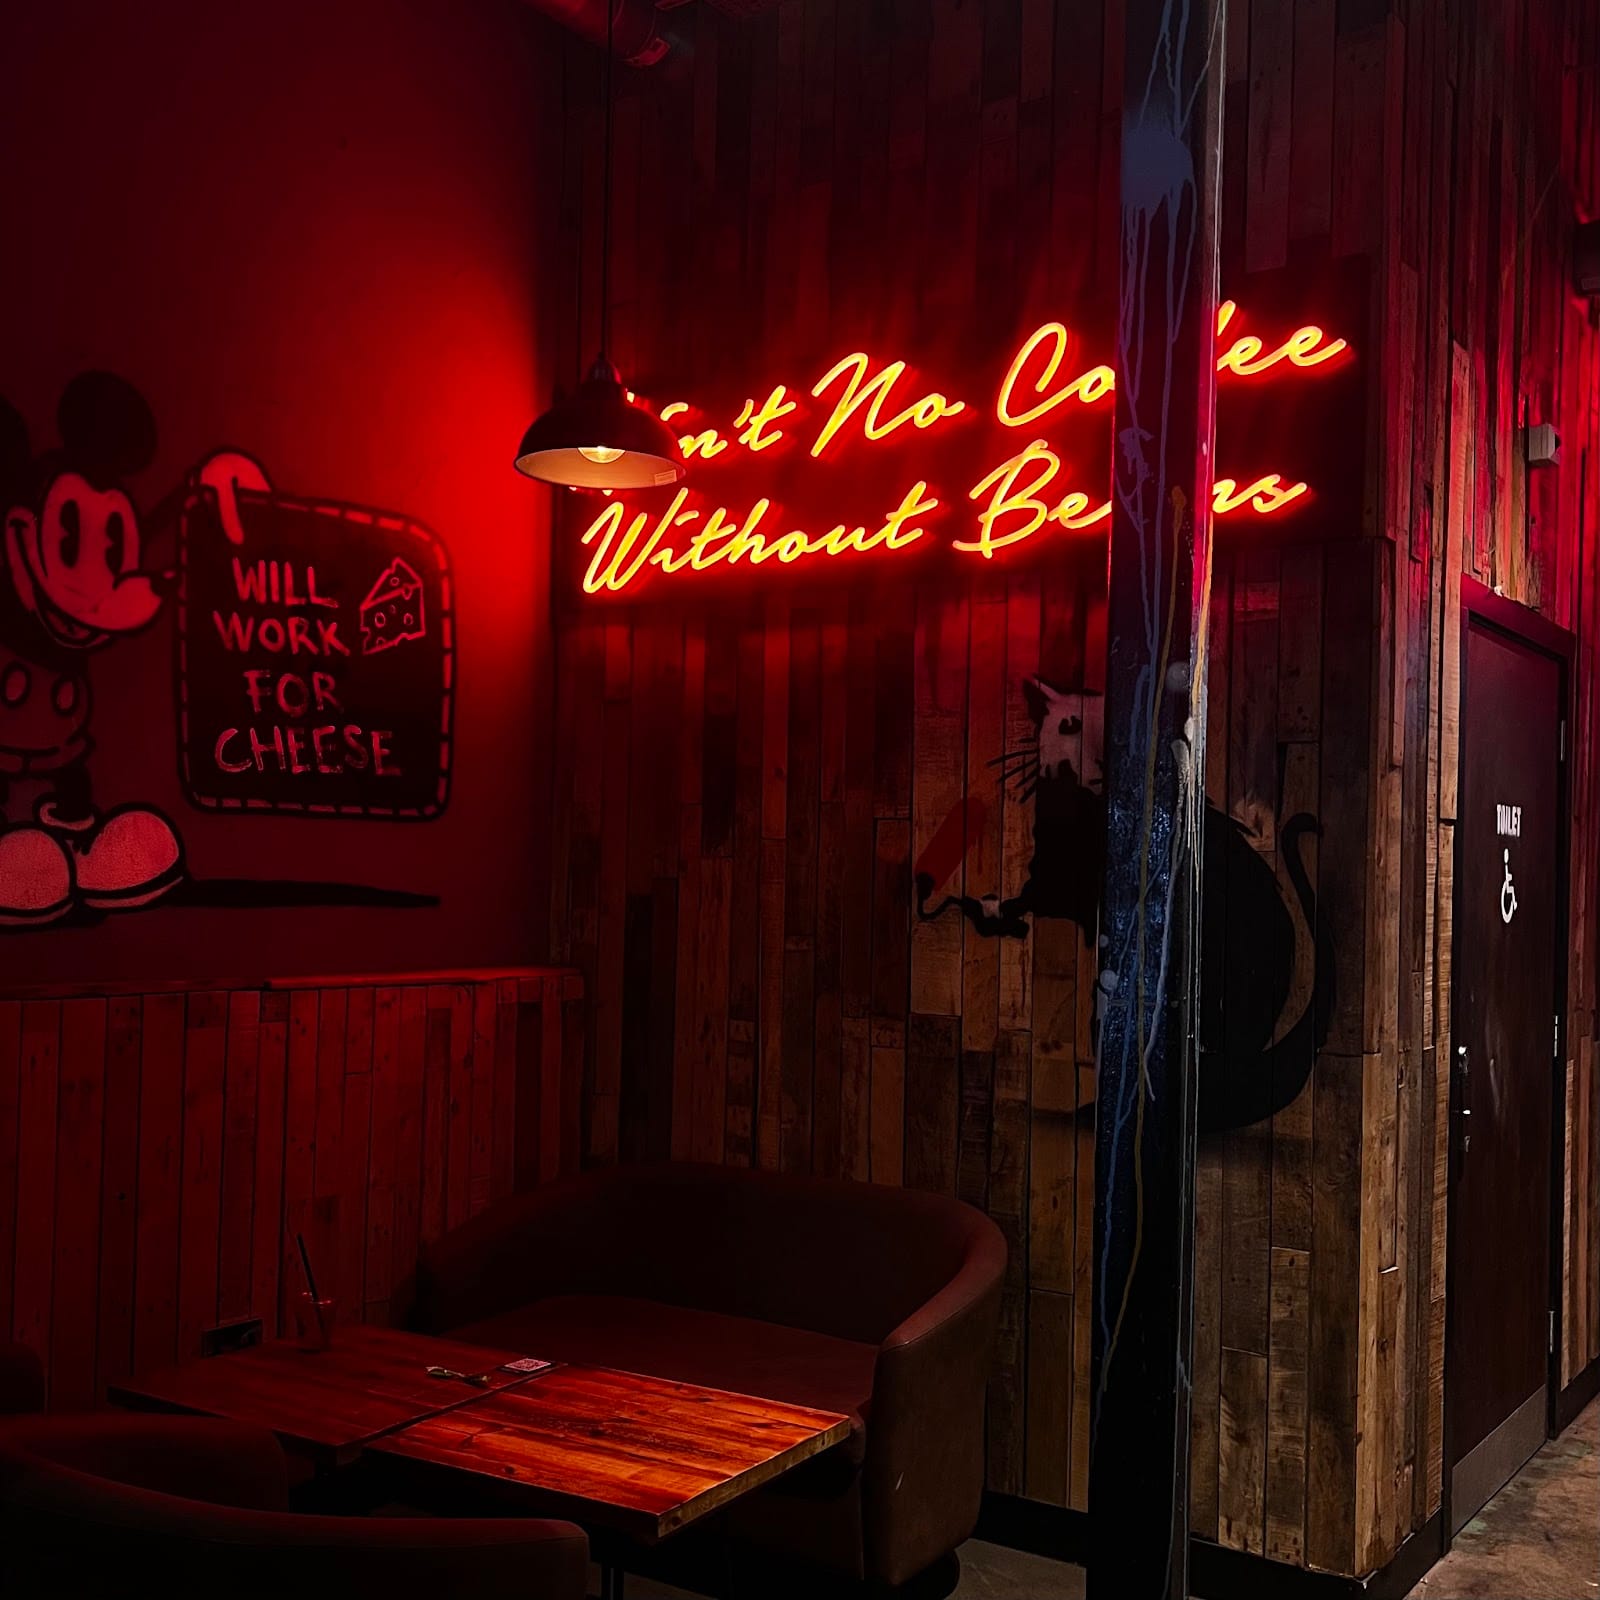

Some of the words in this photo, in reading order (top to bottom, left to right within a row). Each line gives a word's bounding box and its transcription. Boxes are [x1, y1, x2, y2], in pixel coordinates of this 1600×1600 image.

[625, 385, 797, 460] n't
[811, 352, 965, 458] No
[997, 300, 1347, 427] Coee
[581, 480, 939, 594] Without
[952, 439, 1308, 559] Bens
[232, 557, 338, 608] WILL
[213, 610, 349, 656] WORK
[244, 669, 343, 717] FOR
[214, 725, 401, 775] CHEESE
[1496, 804, 1521, 837] TOILET
